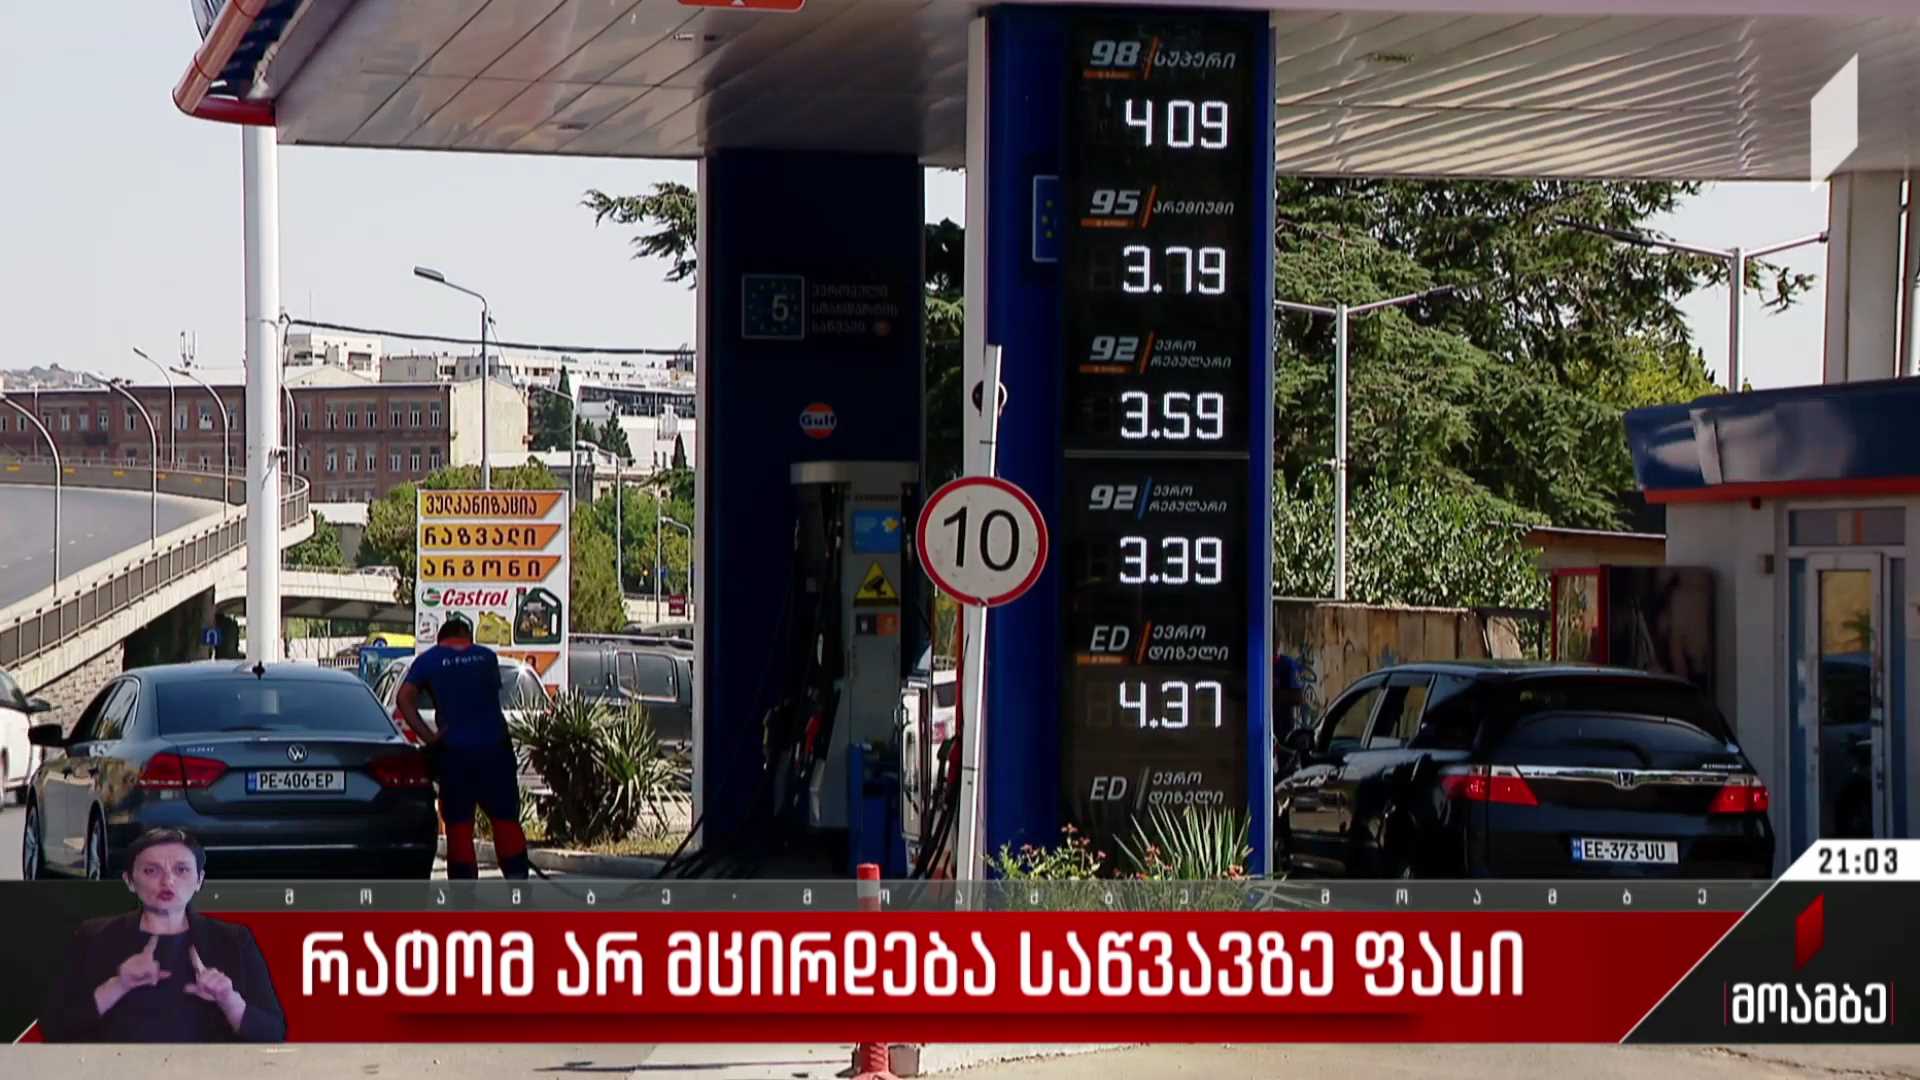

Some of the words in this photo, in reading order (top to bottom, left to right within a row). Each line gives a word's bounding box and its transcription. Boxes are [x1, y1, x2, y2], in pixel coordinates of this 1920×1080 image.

[1090, 40, 1141, 67] 98
[1154, 44, 1236, 69] სუპერი
[1090, 190, 1141, 215] 95
[1123, 245, 1226, 294] 3.79
[771, 294, 789, 322] 5
[1089, 336, 1139, 361] 92
[1121, 391, 1223, 440] 3.59
[426, 495, 538, 516] ვულკანიზაცია
[1089, 485, 1138, 510] 92
[424, 527, 537, 546] რაზვალი
[944, 506, 1020, 571] 10
[423, 559, 541, 577] არგონი
[1119, 536, 1222, 584] 3.39
[442, 588, 510, 607] Castrol
[1090, 625, 1130, 651] ED
[1153, 625, 1207, 640] ევრო
[1148, 646, 1229, 661] დიზელი
[1119, 681, 1221, 728] 4.37
[1090, 777, 1127, 800] ED
[1152, 772, 1202, 785] ევრო
